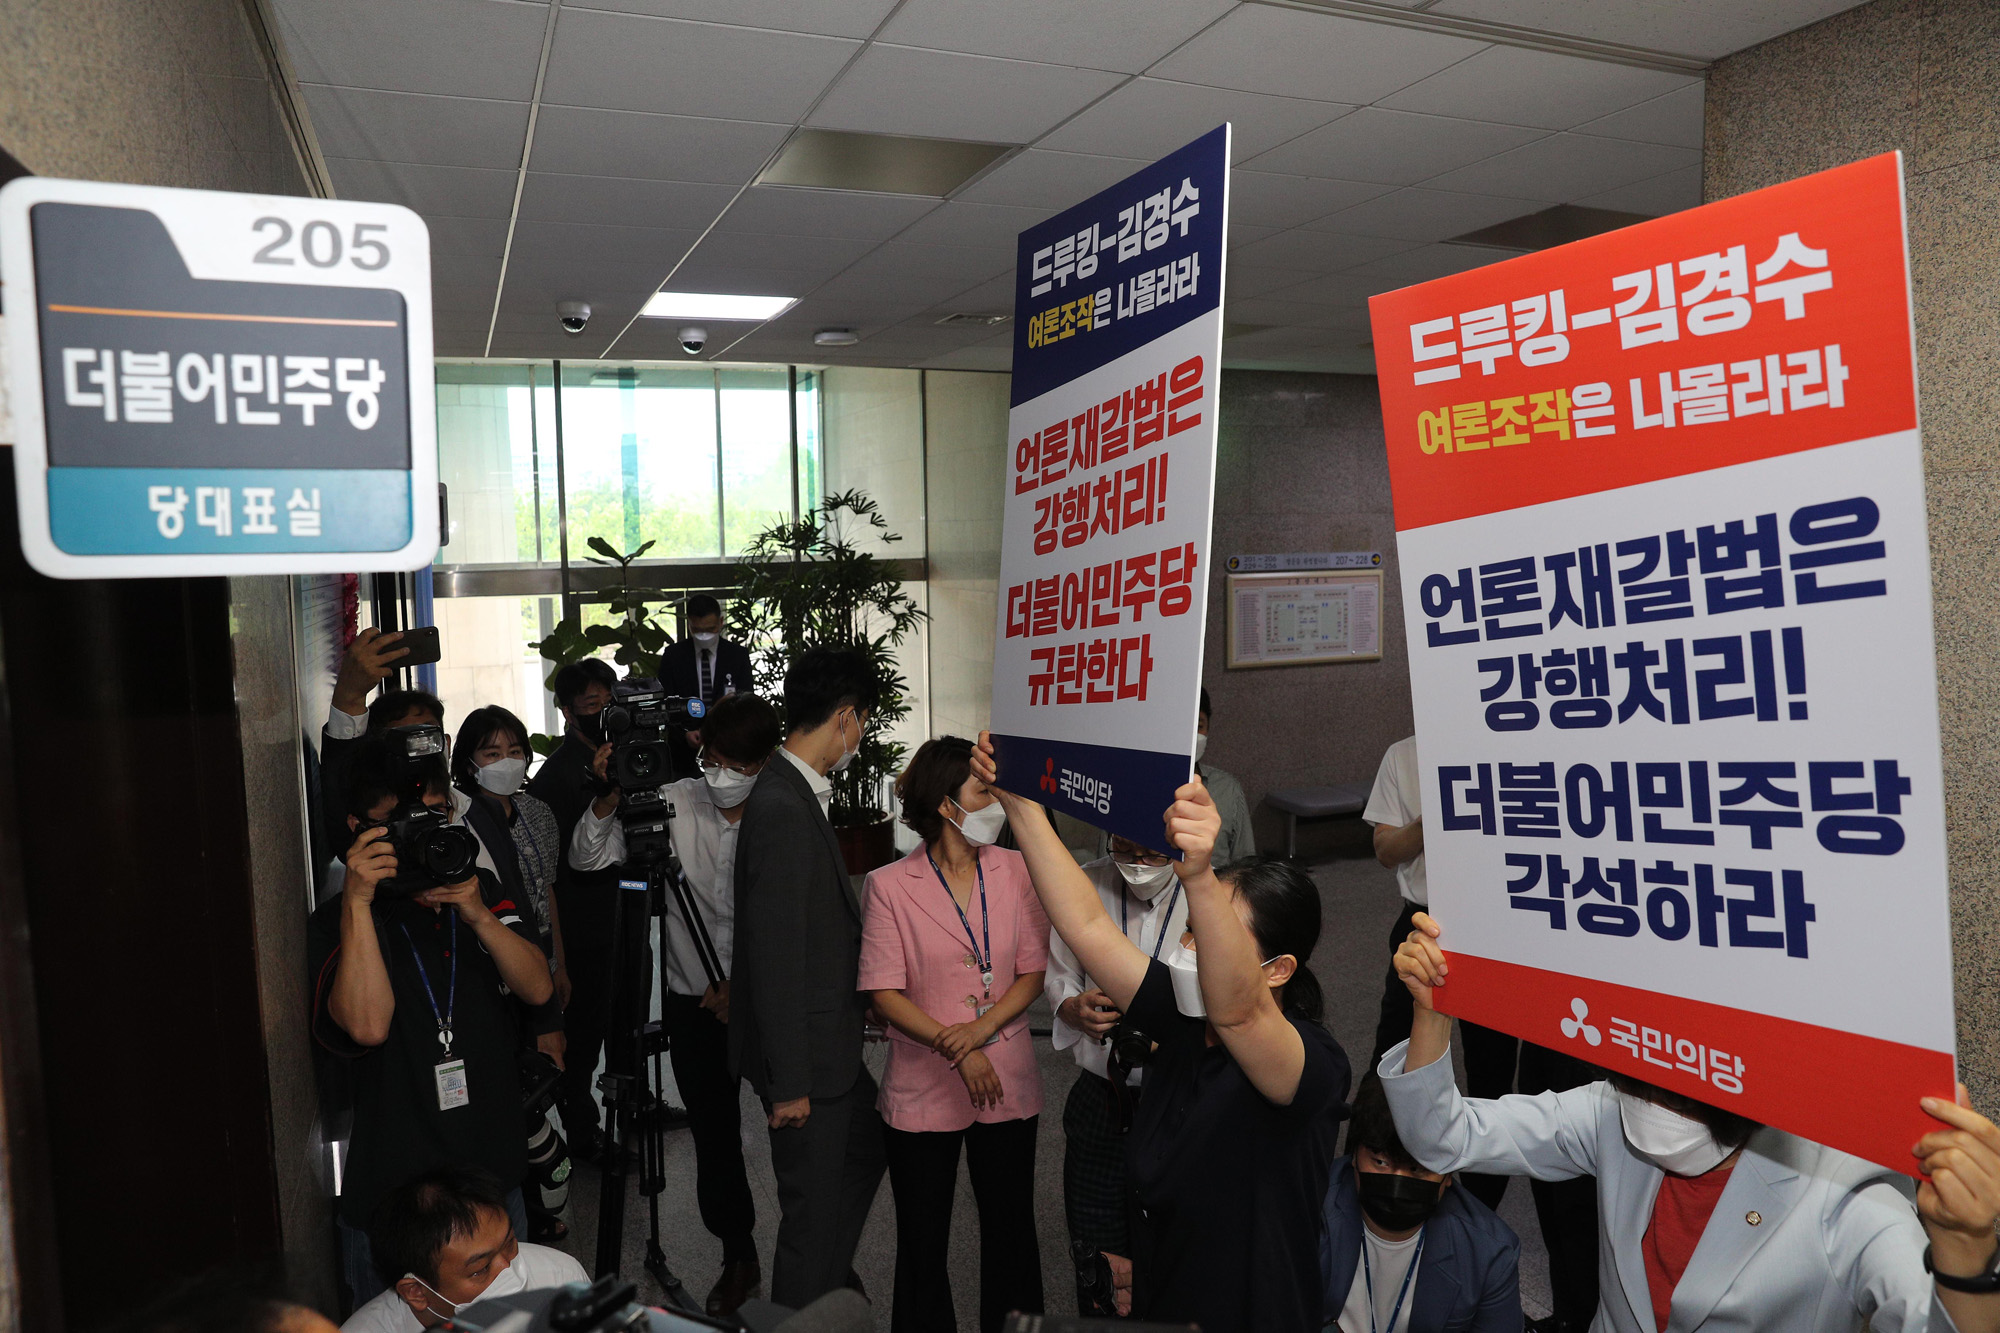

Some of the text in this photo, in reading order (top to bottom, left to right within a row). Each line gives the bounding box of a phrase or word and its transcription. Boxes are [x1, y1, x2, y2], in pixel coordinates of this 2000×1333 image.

[251, 216, 391, 272] 205
[1028, 251, 1201, 349] 여론조작은 나몰라라
[62, 347, 387, 431] 더불어민주당
[1014, 354, 1204, 497] 언론재갈법은
[1416, 343, 1850, 455] 여론조작은 나몰라라
[147, 485, 322, 540] 당대표실
[1033, 451, 1169, 556] 강행처리!
[1005, 541, 1198, 639] 더불어민주당
[1419, 495, 1887, 648] 언론재갈법은
[1028, 633, 1154, 706] 규탄한다
[1476, 626, 1809, 732] 강행처리!
[1059, 768, 1113, 815] 국민의당
[1437, 758, 1912, 857] 더불어민주당
[1504, 852, 1817, 960] 각성하라
[1608, 1015, 1746, 1095] 국민의당
